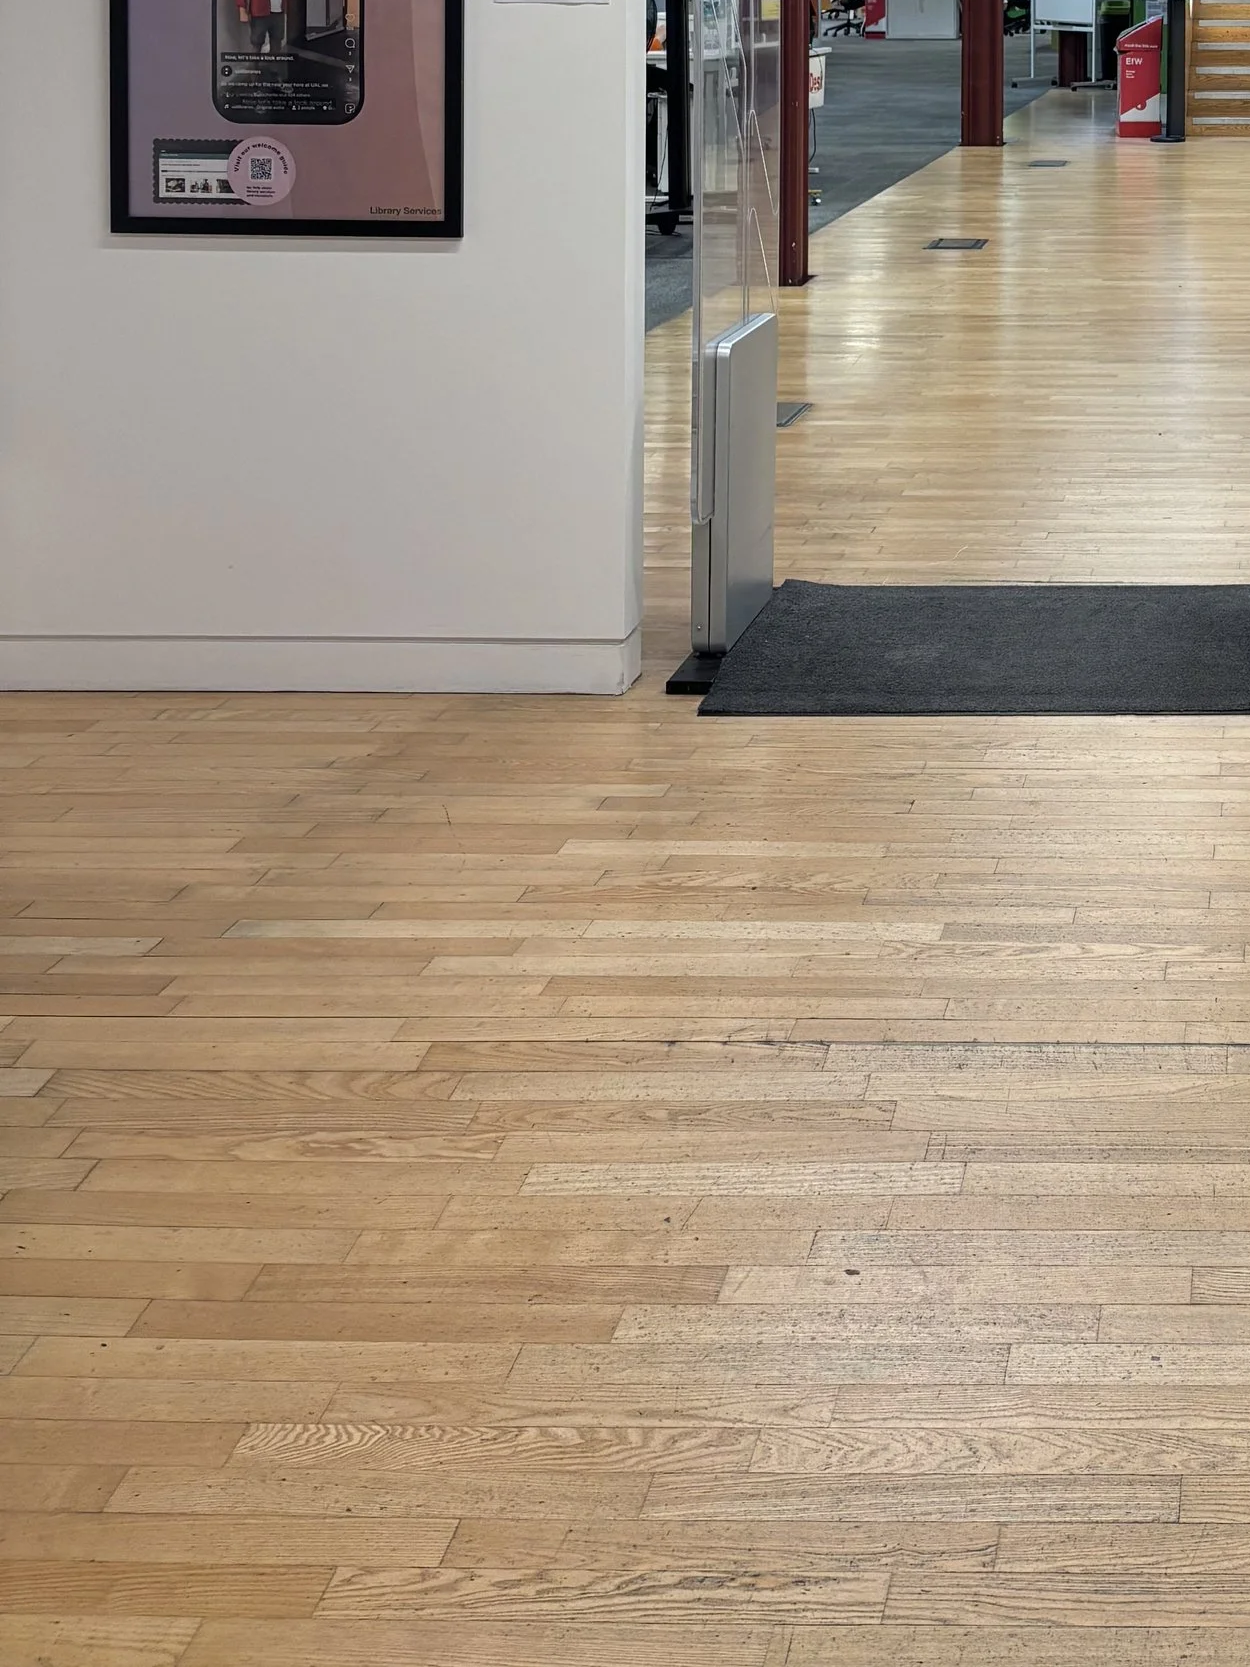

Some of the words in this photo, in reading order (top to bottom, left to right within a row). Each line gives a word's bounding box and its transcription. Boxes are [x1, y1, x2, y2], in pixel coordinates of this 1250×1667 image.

[241, 146, 250, 155] our
[252, 143, 281, 155] welcome
[369, 206, 401, 216] Library
[404, 207, 442, 215] Services
